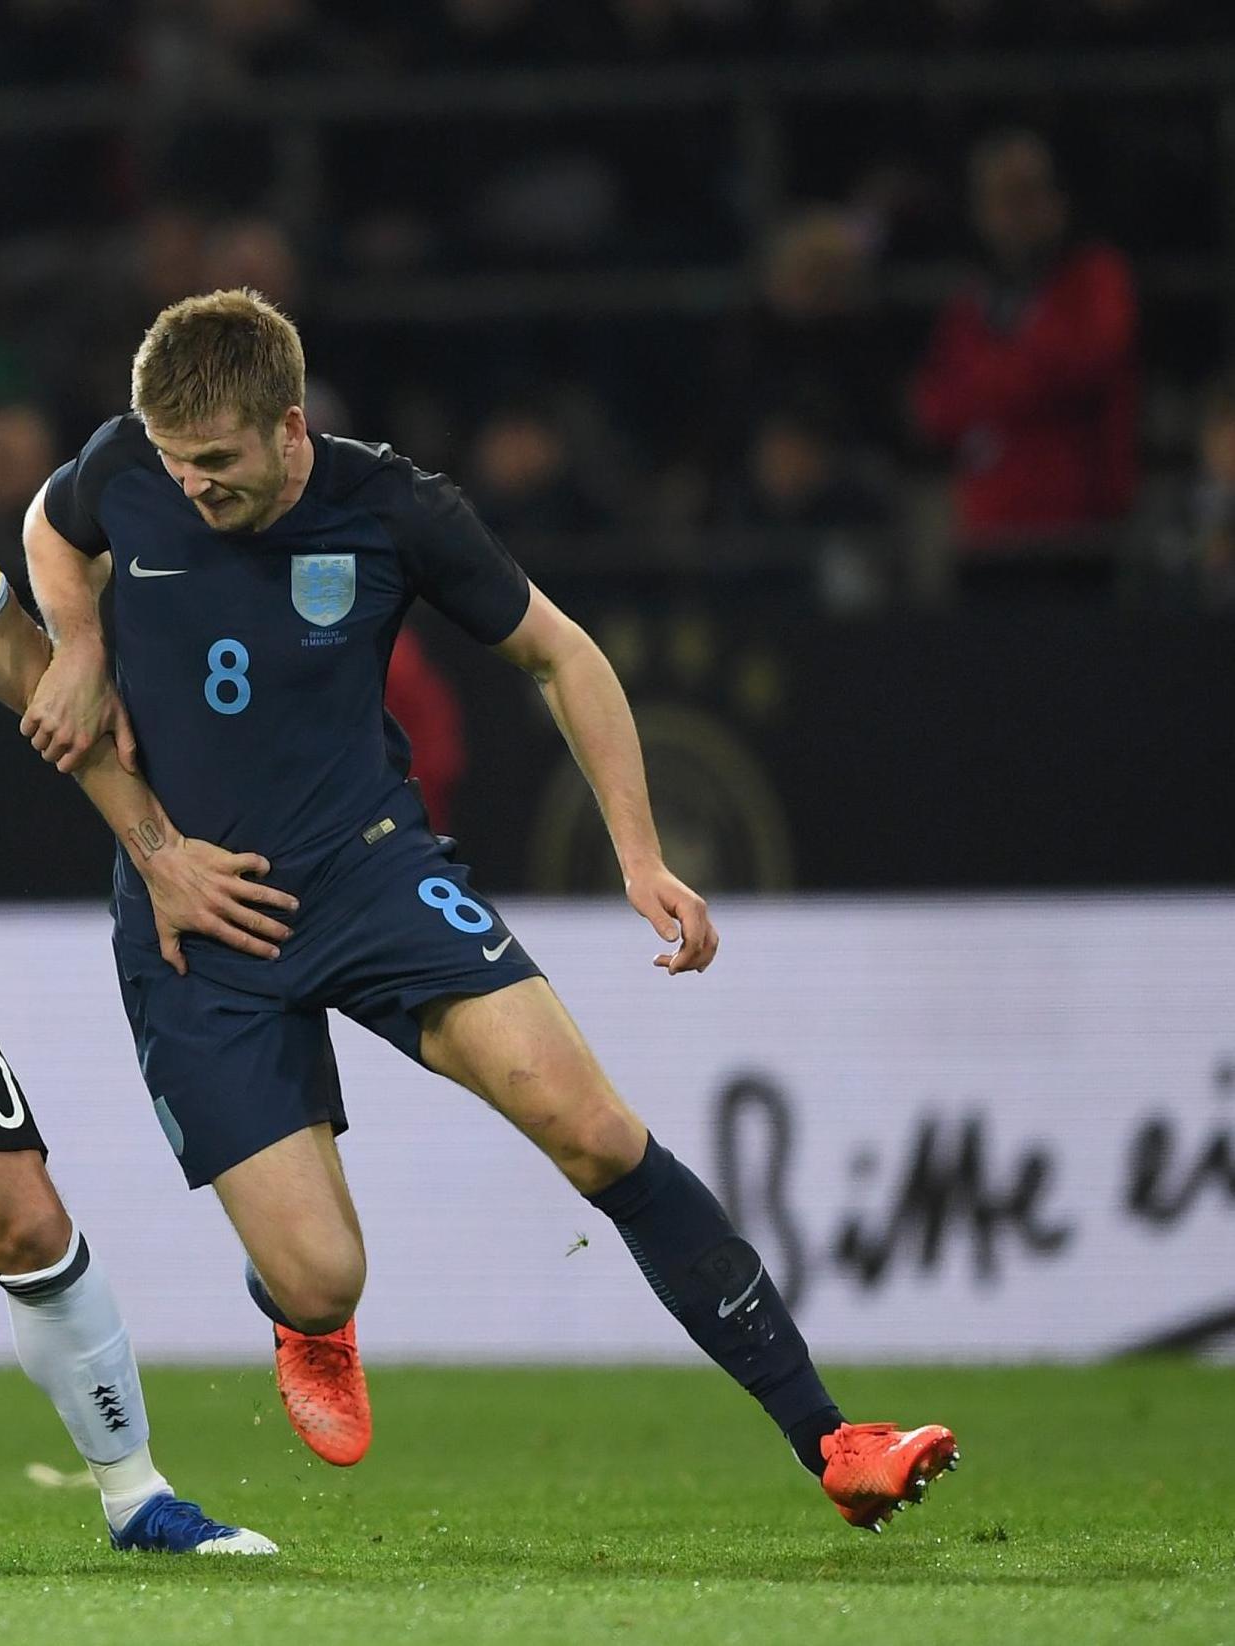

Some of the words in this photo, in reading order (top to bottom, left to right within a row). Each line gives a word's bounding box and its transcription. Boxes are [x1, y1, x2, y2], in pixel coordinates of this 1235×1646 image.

[204, 638, 251, 715] 8
[127, 817, 166, 861] 10
[417, 877, 494, 934] 8
